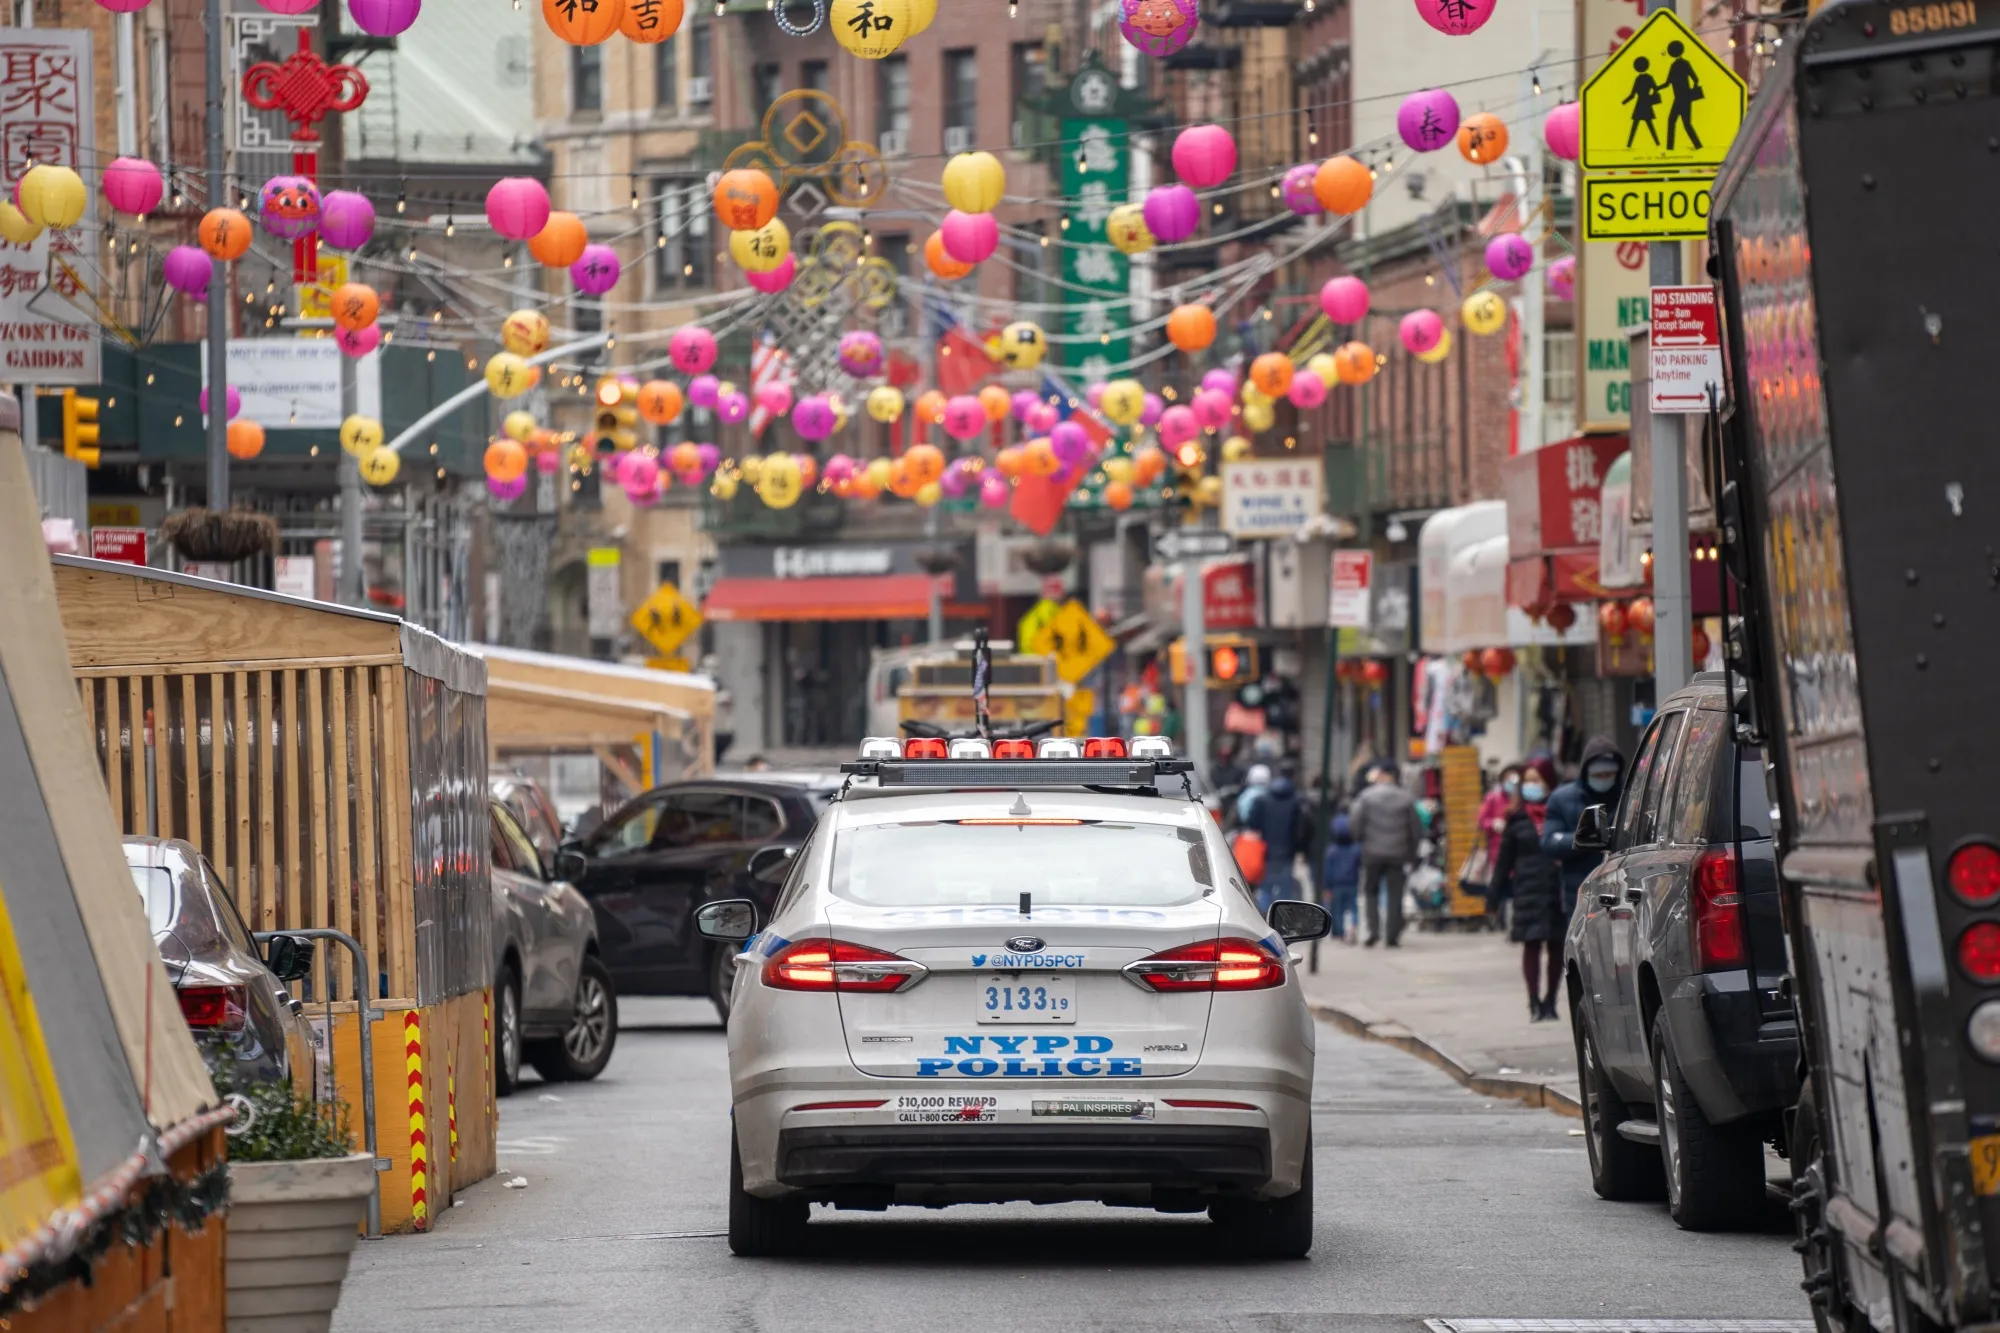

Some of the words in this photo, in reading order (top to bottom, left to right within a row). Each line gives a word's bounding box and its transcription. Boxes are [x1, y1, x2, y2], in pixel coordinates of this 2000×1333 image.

[847, 1, 893, 39] 和
[1889, 1, 1977, 36] 858131
[1420, 106, 1446, 142] 春
[1597, 190, 1711, 222] SCHOO
[1653, 293, 1668, 305] NO
[1669, 291, 1714, 305] STANDING
[1654, 308, 1670, 319] 7am
[1654, 321, 1677, 332] Except
[1678, 319, 1705, 331] Sunday
[6, 350, 84, 368] GARDEN
[1655, 354, 1668, 366] NO
[1669, 353, 1709, 366] PARKING
[1655, 369, 1692, 382] Anytime
[95, 533, 105, 543] NO
[106, 534, 137, 544] STANDING
[96, 544, 123, 554] Anytime
[1014, 940, 1037, 951] Ford
[991, 955, 1085, 967] @NYPD5PCT
[985, 987, 1047, 1010] 3133
[1051, 998, 1069, 1010] 19
[944, 1036, 1114, 1055] NYPD
[916, 1058, 1142, 1076] POLICE
[898, 1096, 945, 1109] $10,000
[948, 1096, 997, 1107] REWARD
[1062, 1103, 1082, 1112] PAL
[1084, 1103, 1132, 1113] INSPIRES
[899, 1113, 917, 1122] CALL
[919, 1113, 940, 1122] 1-800
